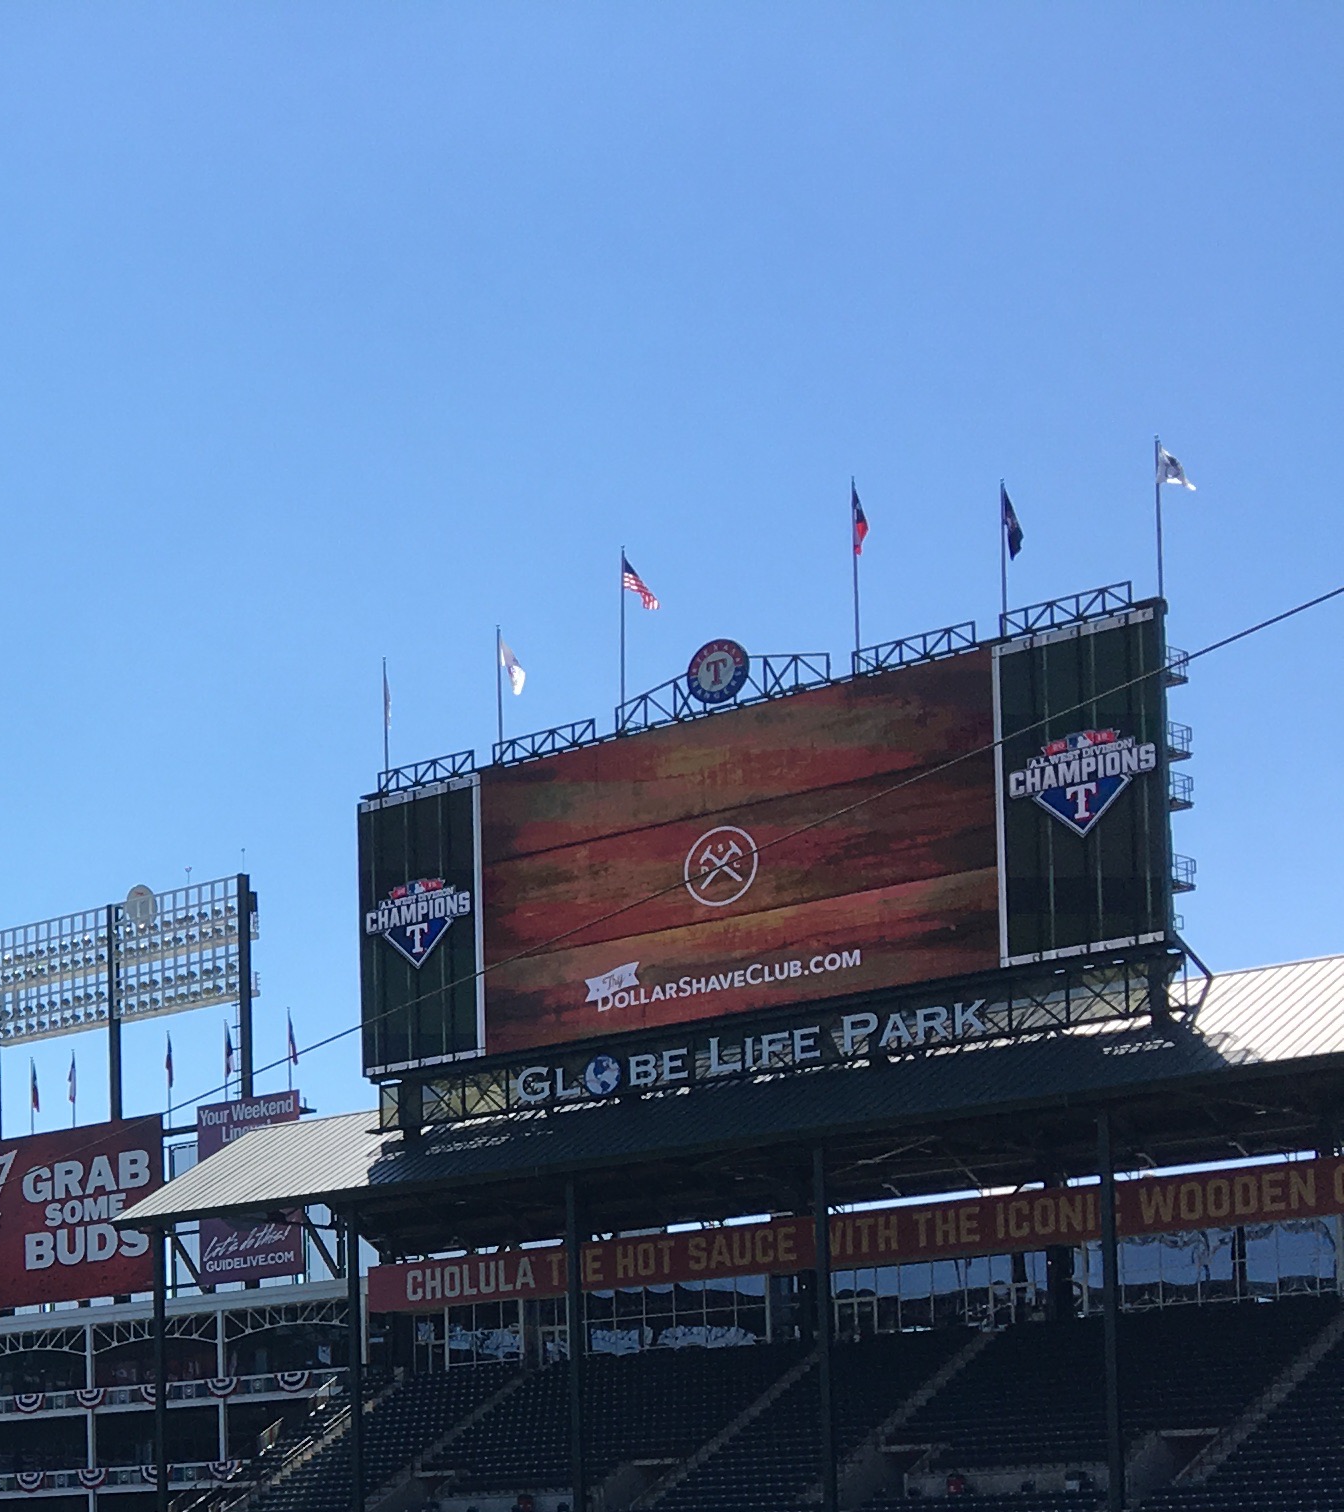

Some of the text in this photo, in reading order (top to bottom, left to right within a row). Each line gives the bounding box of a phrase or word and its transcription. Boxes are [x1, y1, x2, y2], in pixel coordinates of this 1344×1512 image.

[1009, 743, 1157, 798] CHAMPIONS
[365, 891, 471, 935] CHAMPIONS
[707, 1024, 821, 1076] LIFE
[839, 998, 987, 1057] PARK
[199, 1095, 294, 1127] Your Weekend
[21, 1149, 151, 1204] GRAB
[44, 1192, 126, 1228] SOME
[405, 1254, 536, 1302] CHOLULA
[546, 1246, 603, 1288] TE
[615, 1239, 675, 1280] HOT
[687, 1224, 798, 1272] SAUCE
[913, 1206, 982, 1246] THE
[995, 1191, 1122, 1240] ICONI
[1139, 1168, 1318, 1225] WOODEN
[23, 1221, 150, 1271] BUDS
[205, 1250, 295, 1273] GUIDELIVE.COM
